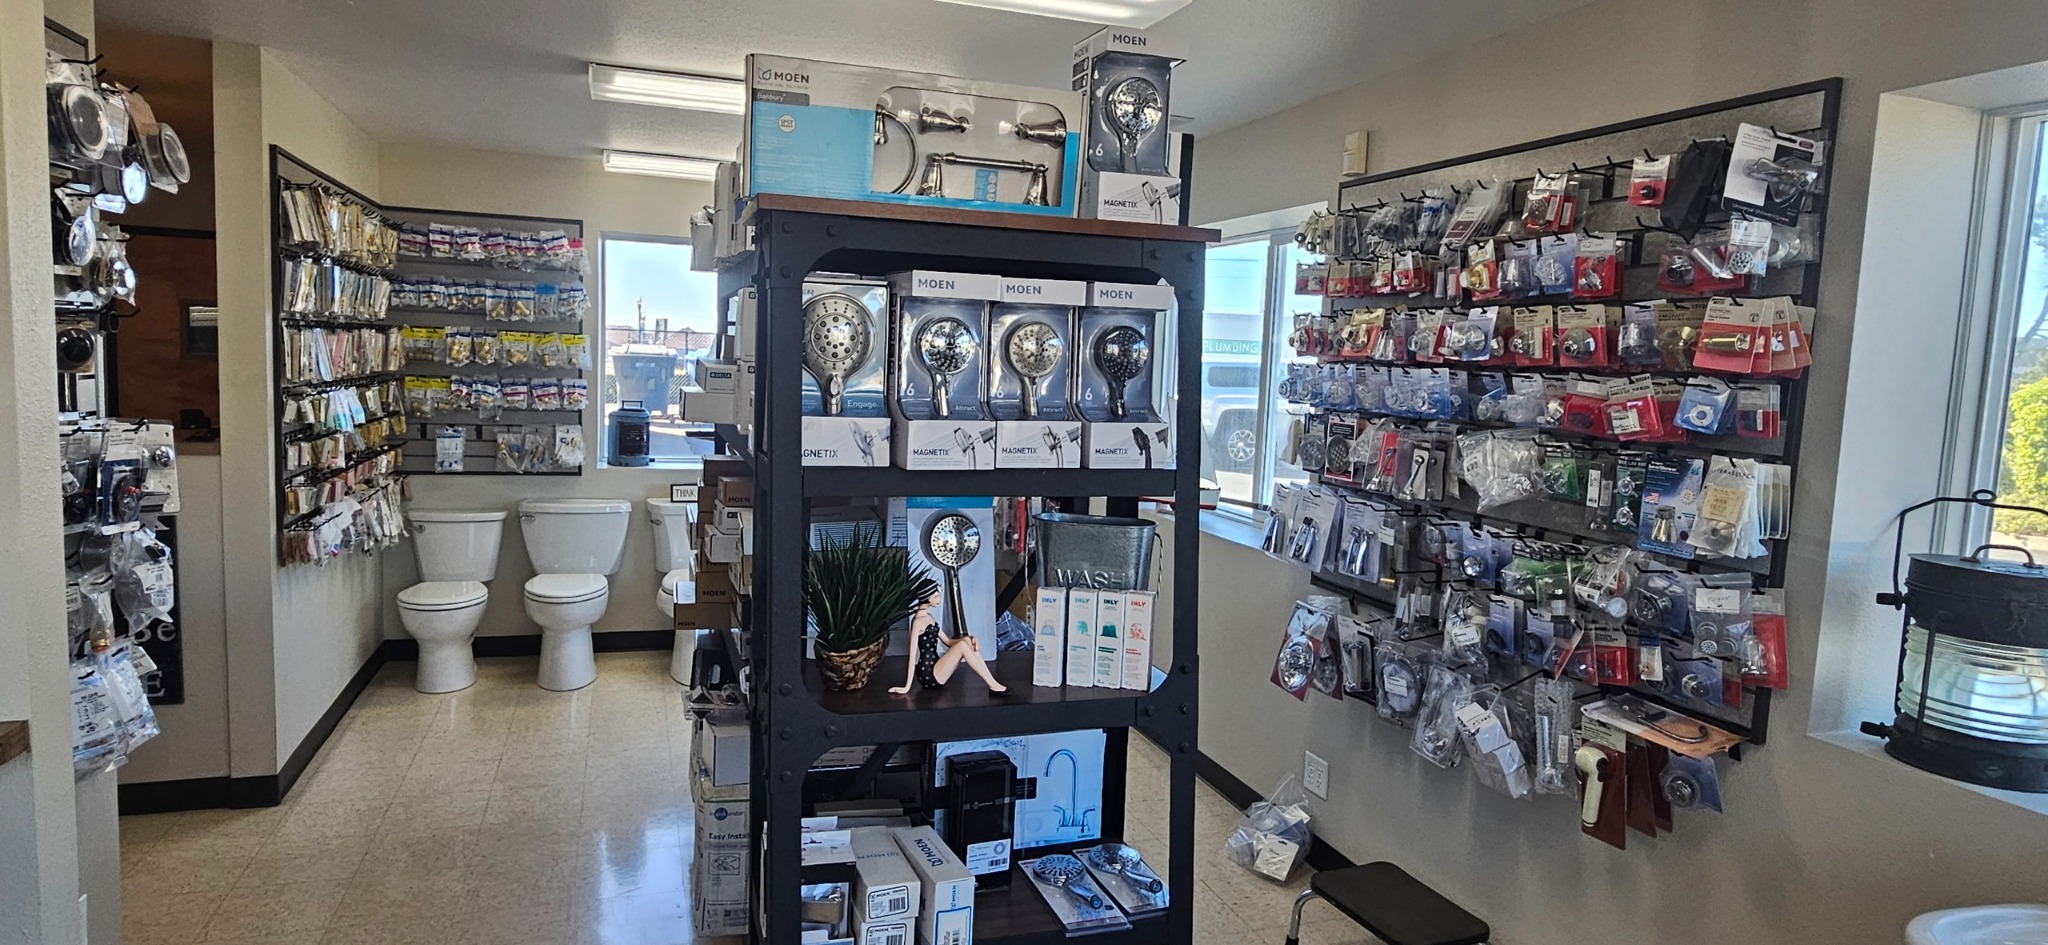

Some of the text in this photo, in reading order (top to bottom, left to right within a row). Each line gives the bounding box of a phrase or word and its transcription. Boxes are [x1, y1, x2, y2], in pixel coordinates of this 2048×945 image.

[1112, 33, 1147, 47] MOEN
[774, 71, 810, 84] MOEN
[1095, 143, 1104, 157] 6
[1103, 198, 1138, 209] MAGNETIX
[918, 278, 956, 290] MOEN
[1006, 284, 1042, 295] MOEN
[803, 288, 814, 296] EN
[1099, 289, 1134, 300] MOEN
[906, 383, 915, 396] 6
[996, 385, 1004, 398] 6
[1084, 387, 1093, 401] 6
[847, 399, 878, 409] Engage
[801, 448, 839, 458] GNETIX
[912, 448, 950, 456] MAGNETIX
[1001, 447, 1038, 455] MAGNETIX
[675, 488, 697, 499] THINK
[1055, 567, 1127, 589] WASH
[1104, 598, 1119, 606] INLY
[709, 832, 726, 841] Easy
[914, 838, 935, 860] MOEN
